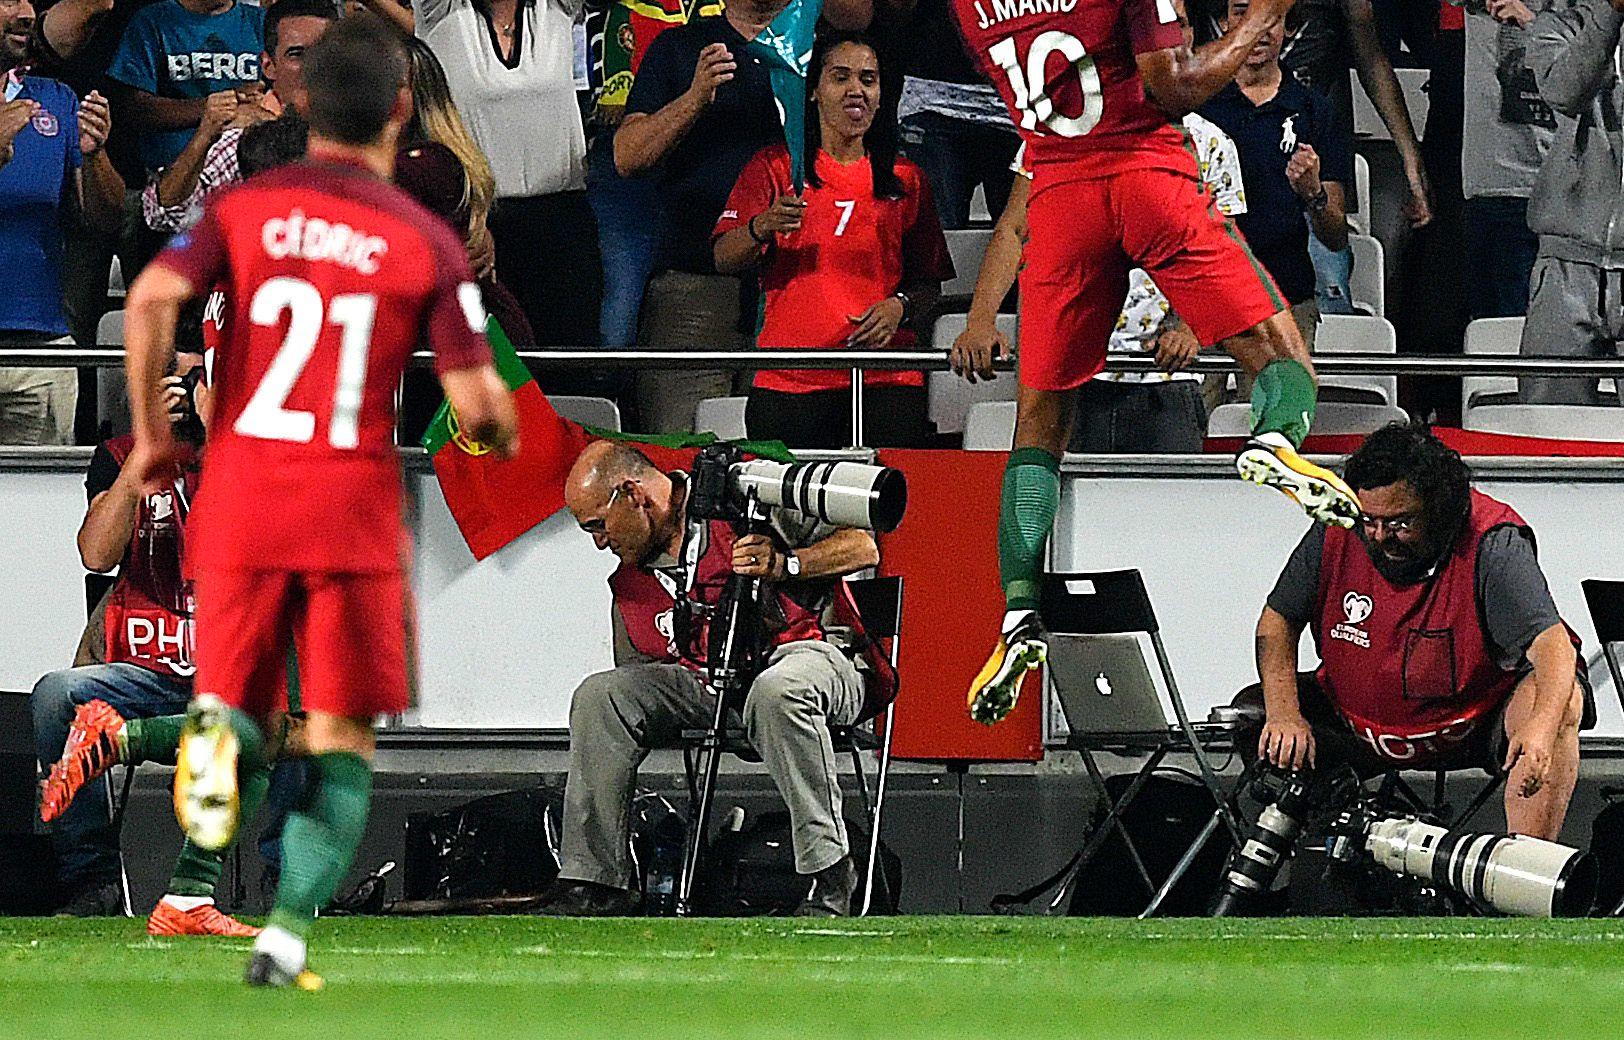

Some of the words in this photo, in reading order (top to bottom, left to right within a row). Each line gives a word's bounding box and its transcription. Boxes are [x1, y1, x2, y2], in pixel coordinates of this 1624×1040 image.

[167, 51, 259, 81] BERG
[988, 30, 1104, 138] 10
[834, 200, 855, 236] 7
[233, 273, 379, 450] 21
